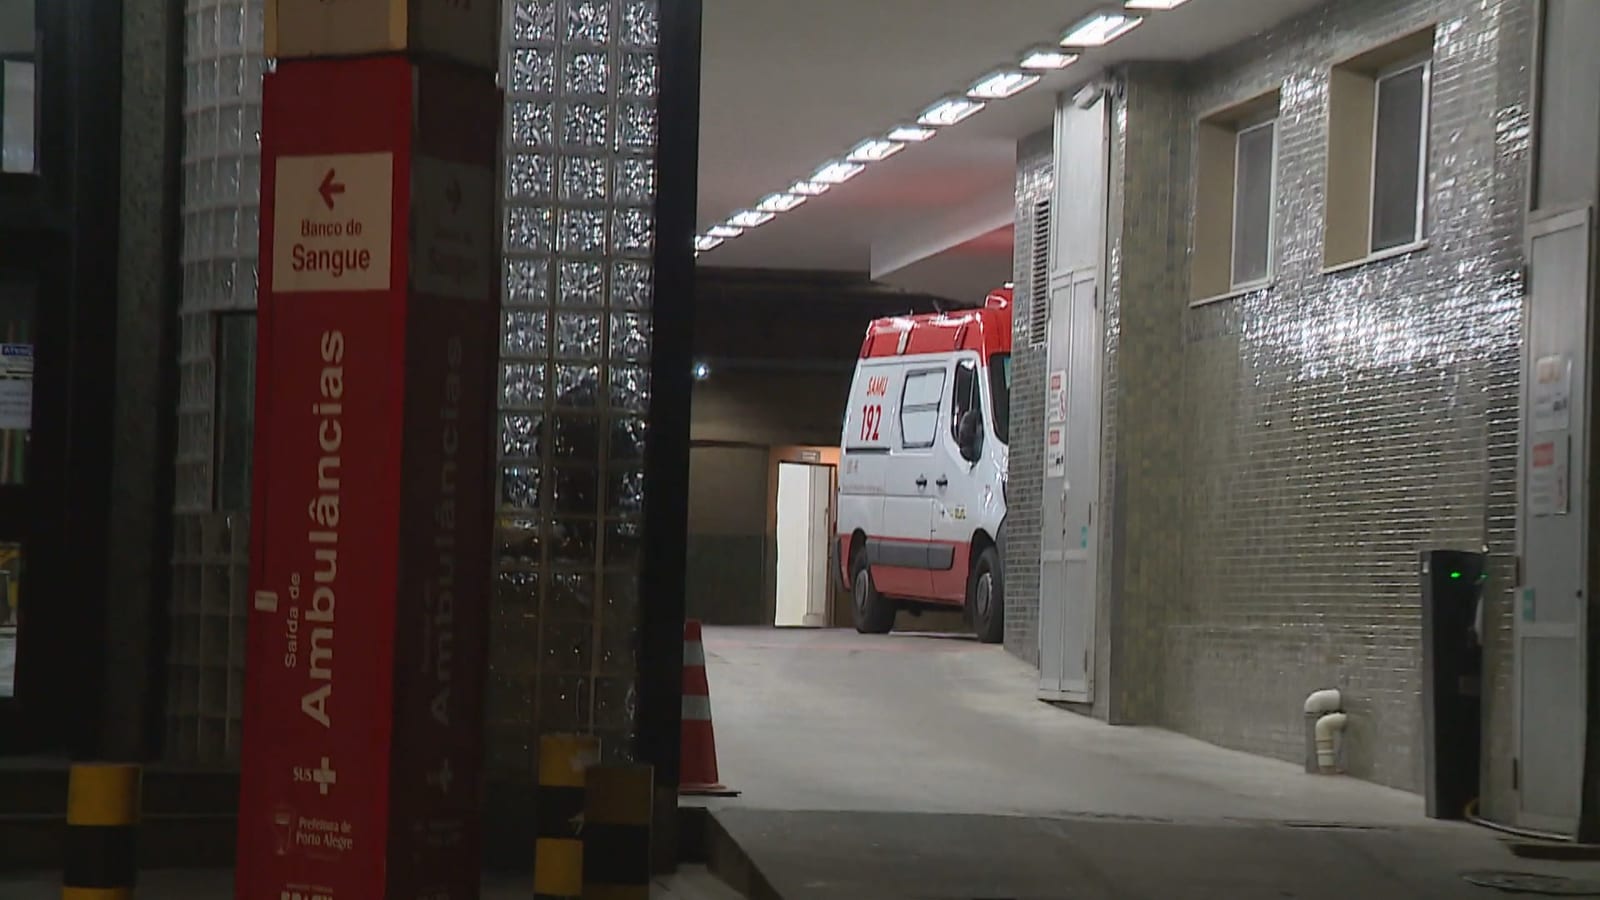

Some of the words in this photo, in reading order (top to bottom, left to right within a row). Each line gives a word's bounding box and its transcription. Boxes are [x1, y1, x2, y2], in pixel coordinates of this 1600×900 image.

[301, 218, 342, 238] Banco
[346, 218, 362, 237] de
[292, 243, 370, 278] Sangue
[866, 376, 889, 397] SAMU
[860, 404, 882, 441] 192
[301, 330, 345, 728] Ambulâncias
[288, 571, 301, 599] de
[284, 606, 299, 668] Saída
[293, 766, 312, 782] SUS
[341, 820, 352, 833] de
[295, 831, 321, 846] Porto
[323, 833, 353, 851] Alegre
